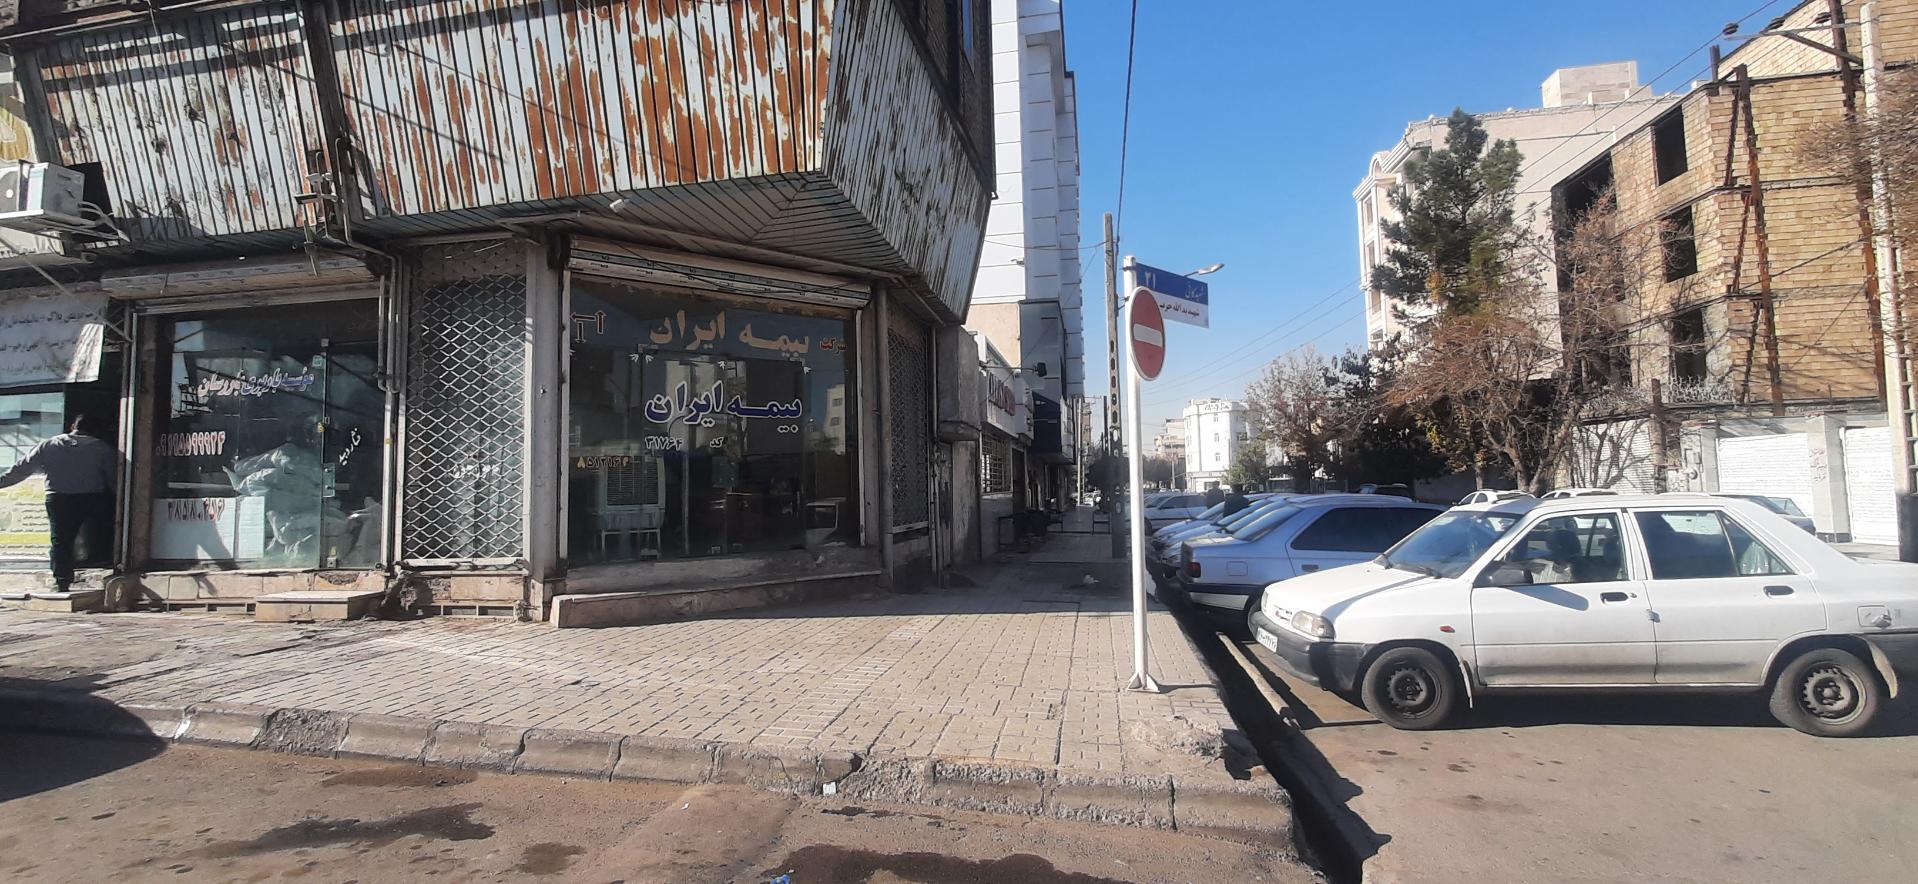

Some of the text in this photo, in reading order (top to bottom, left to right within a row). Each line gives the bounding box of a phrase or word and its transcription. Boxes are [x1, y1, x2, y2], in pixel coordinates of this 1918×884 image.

[649, 309, 726, 351] ایران
[738, 322, 810, 358] بیمه
[645, 380, 803, 433] بیمه ایران
[645, 436, 725, 450] کد ۳۱۷۶۴
